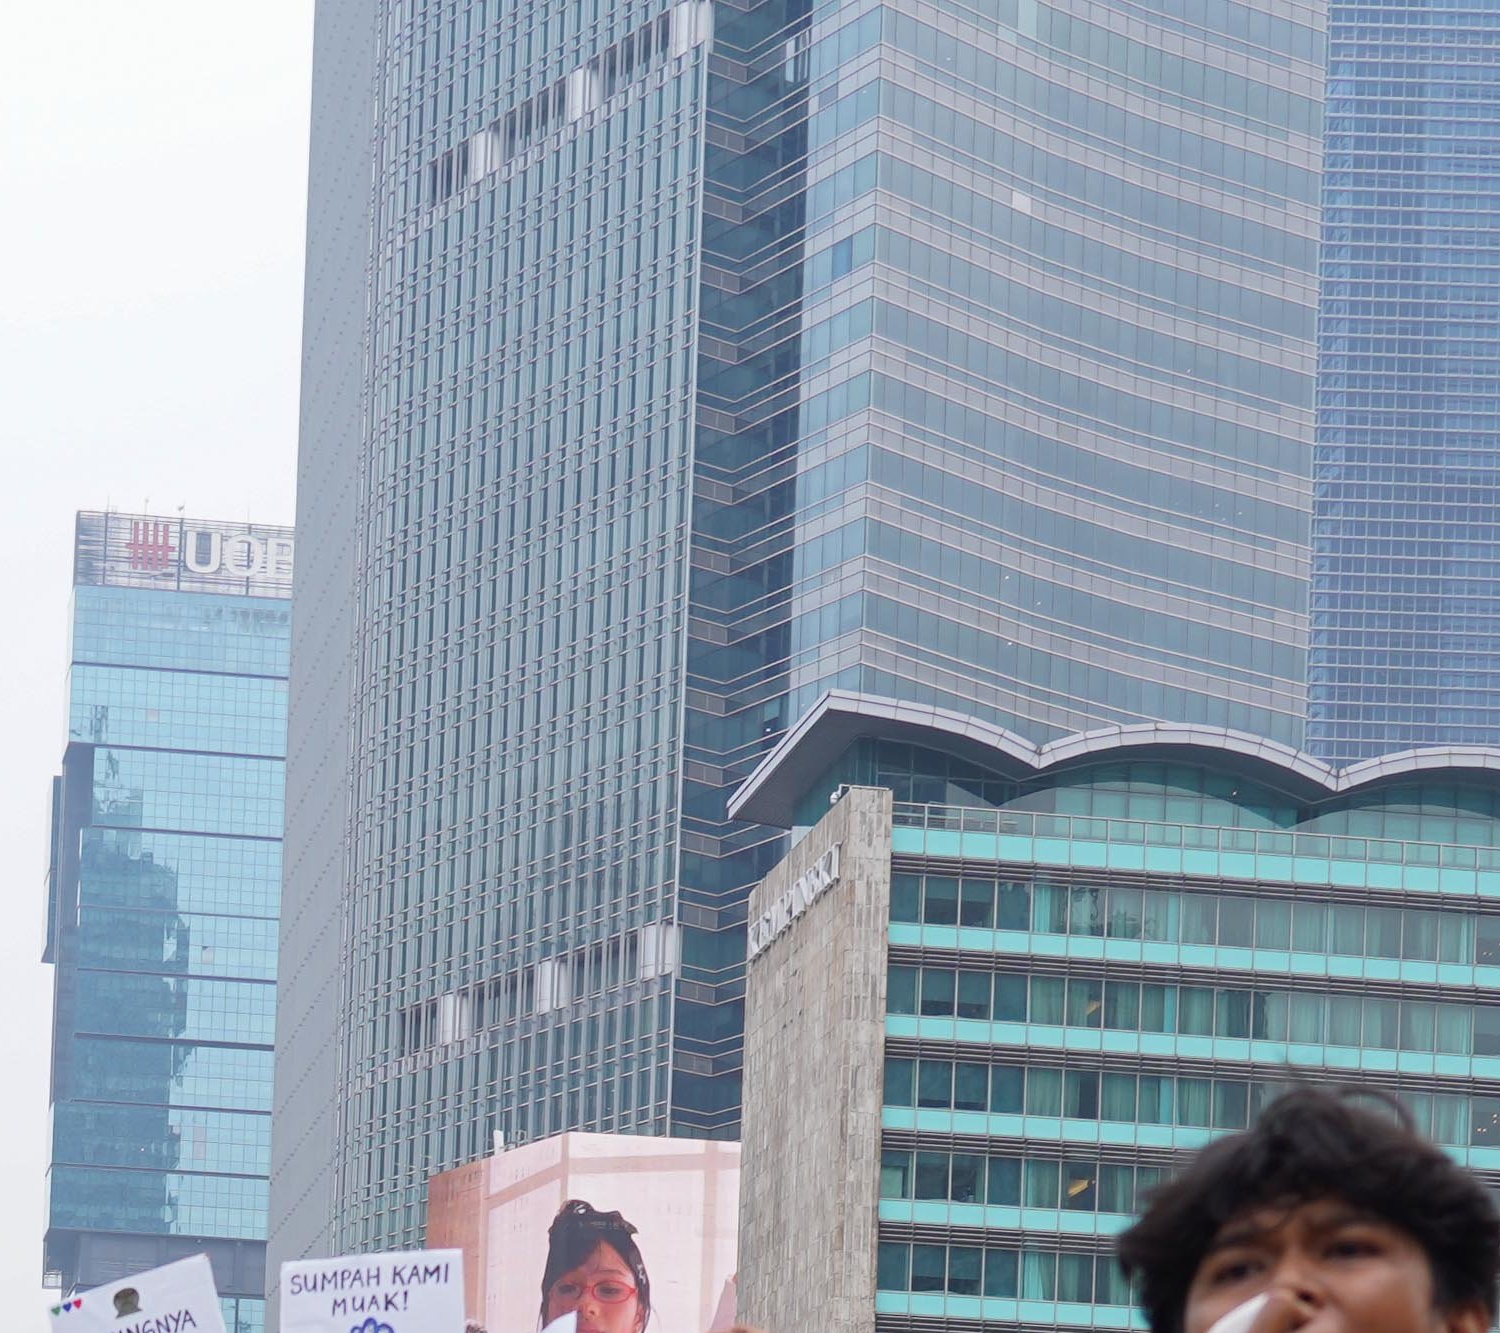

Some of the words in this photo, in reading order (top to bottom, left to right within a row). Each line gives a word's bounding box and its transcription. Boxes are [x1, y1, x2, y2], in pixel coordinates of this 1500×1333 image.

[290, 1266, 381, 1295] SUMPAH
[392, 1263, 449, 1286] KAMI
[332, 1290, 408, 1317] MUAK!
